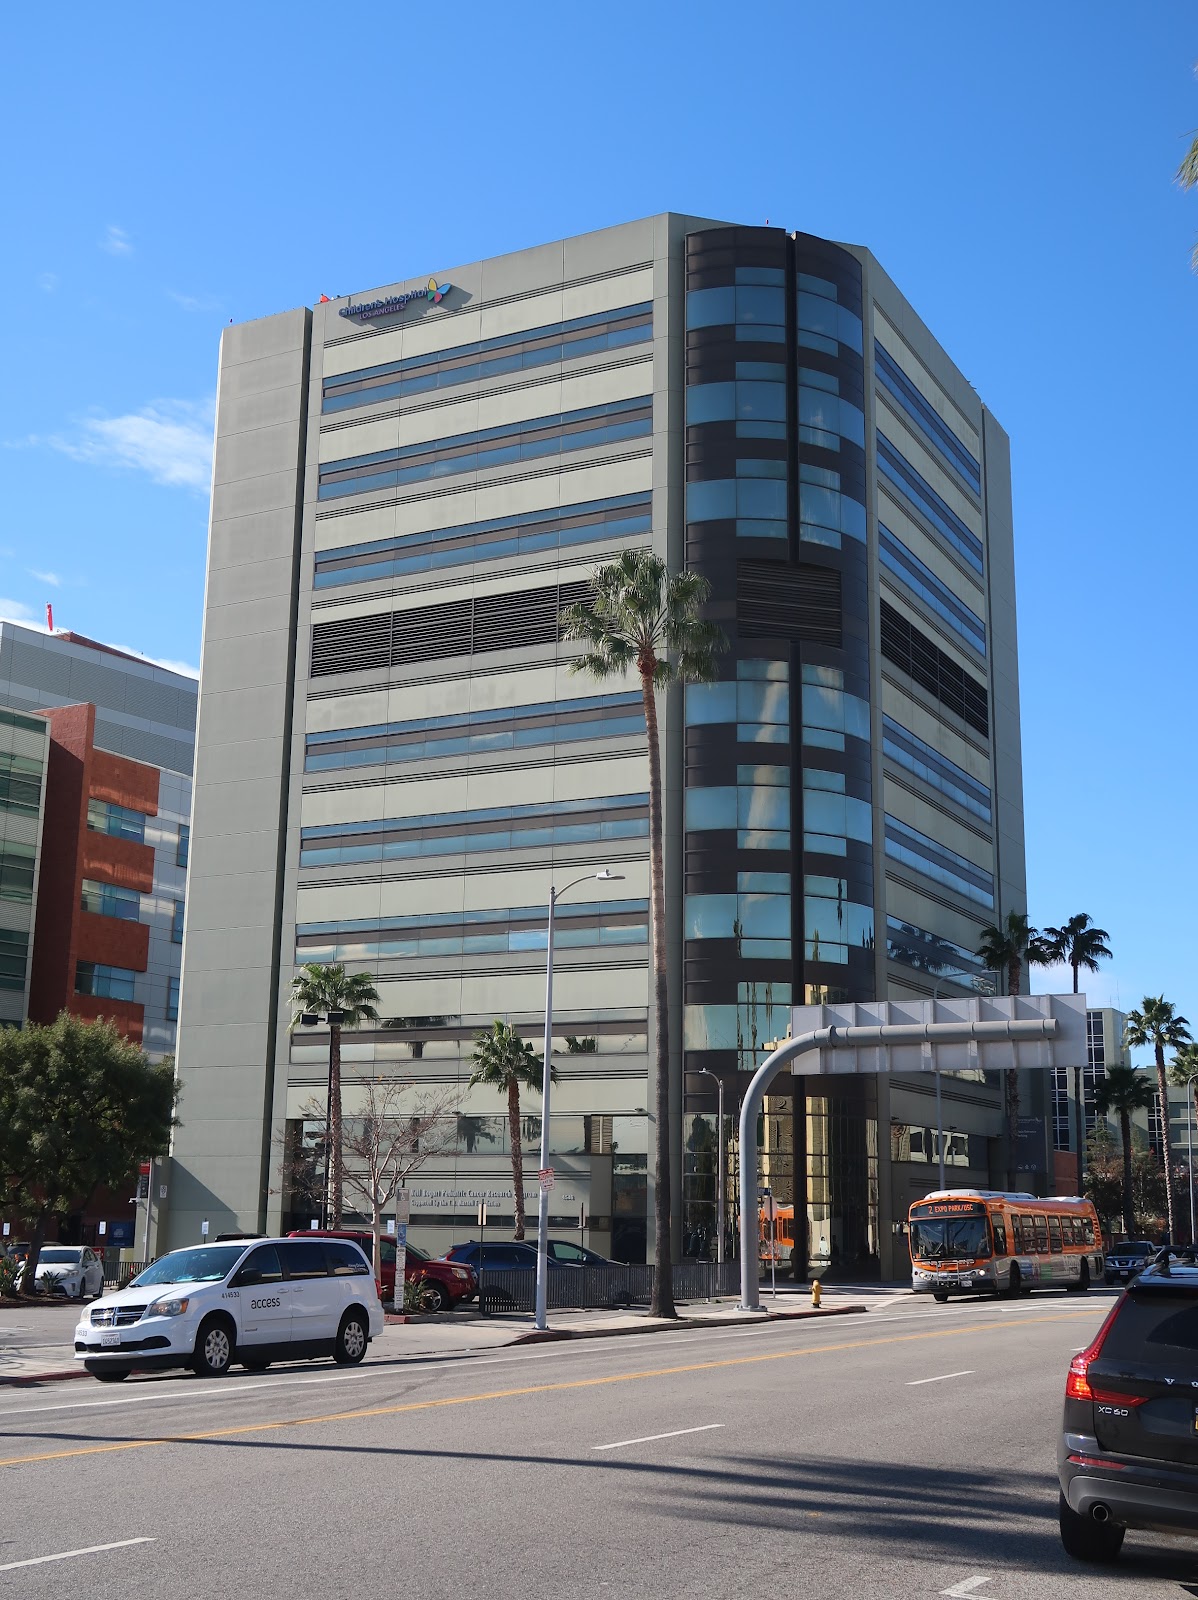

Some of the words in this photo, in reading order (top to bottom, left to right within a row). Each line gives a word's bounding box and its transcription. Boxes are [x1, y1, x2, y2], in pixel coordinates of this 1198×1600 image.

[384, 286, 428, 305] Hospital
[359, 311, 372, 320] LOS
[372, 303, 405, 317] ANGELES
[928, 1205, 933, 1214] 2
[934, 1205, 948, 1213] EXPO
[948, 1203, 974, 1213] PARK/USC
[221, 1291, 240, 1299] 414533
[250, 1297, 281, 1310] access
[1098, 1406, 1129, 1417] XC60
